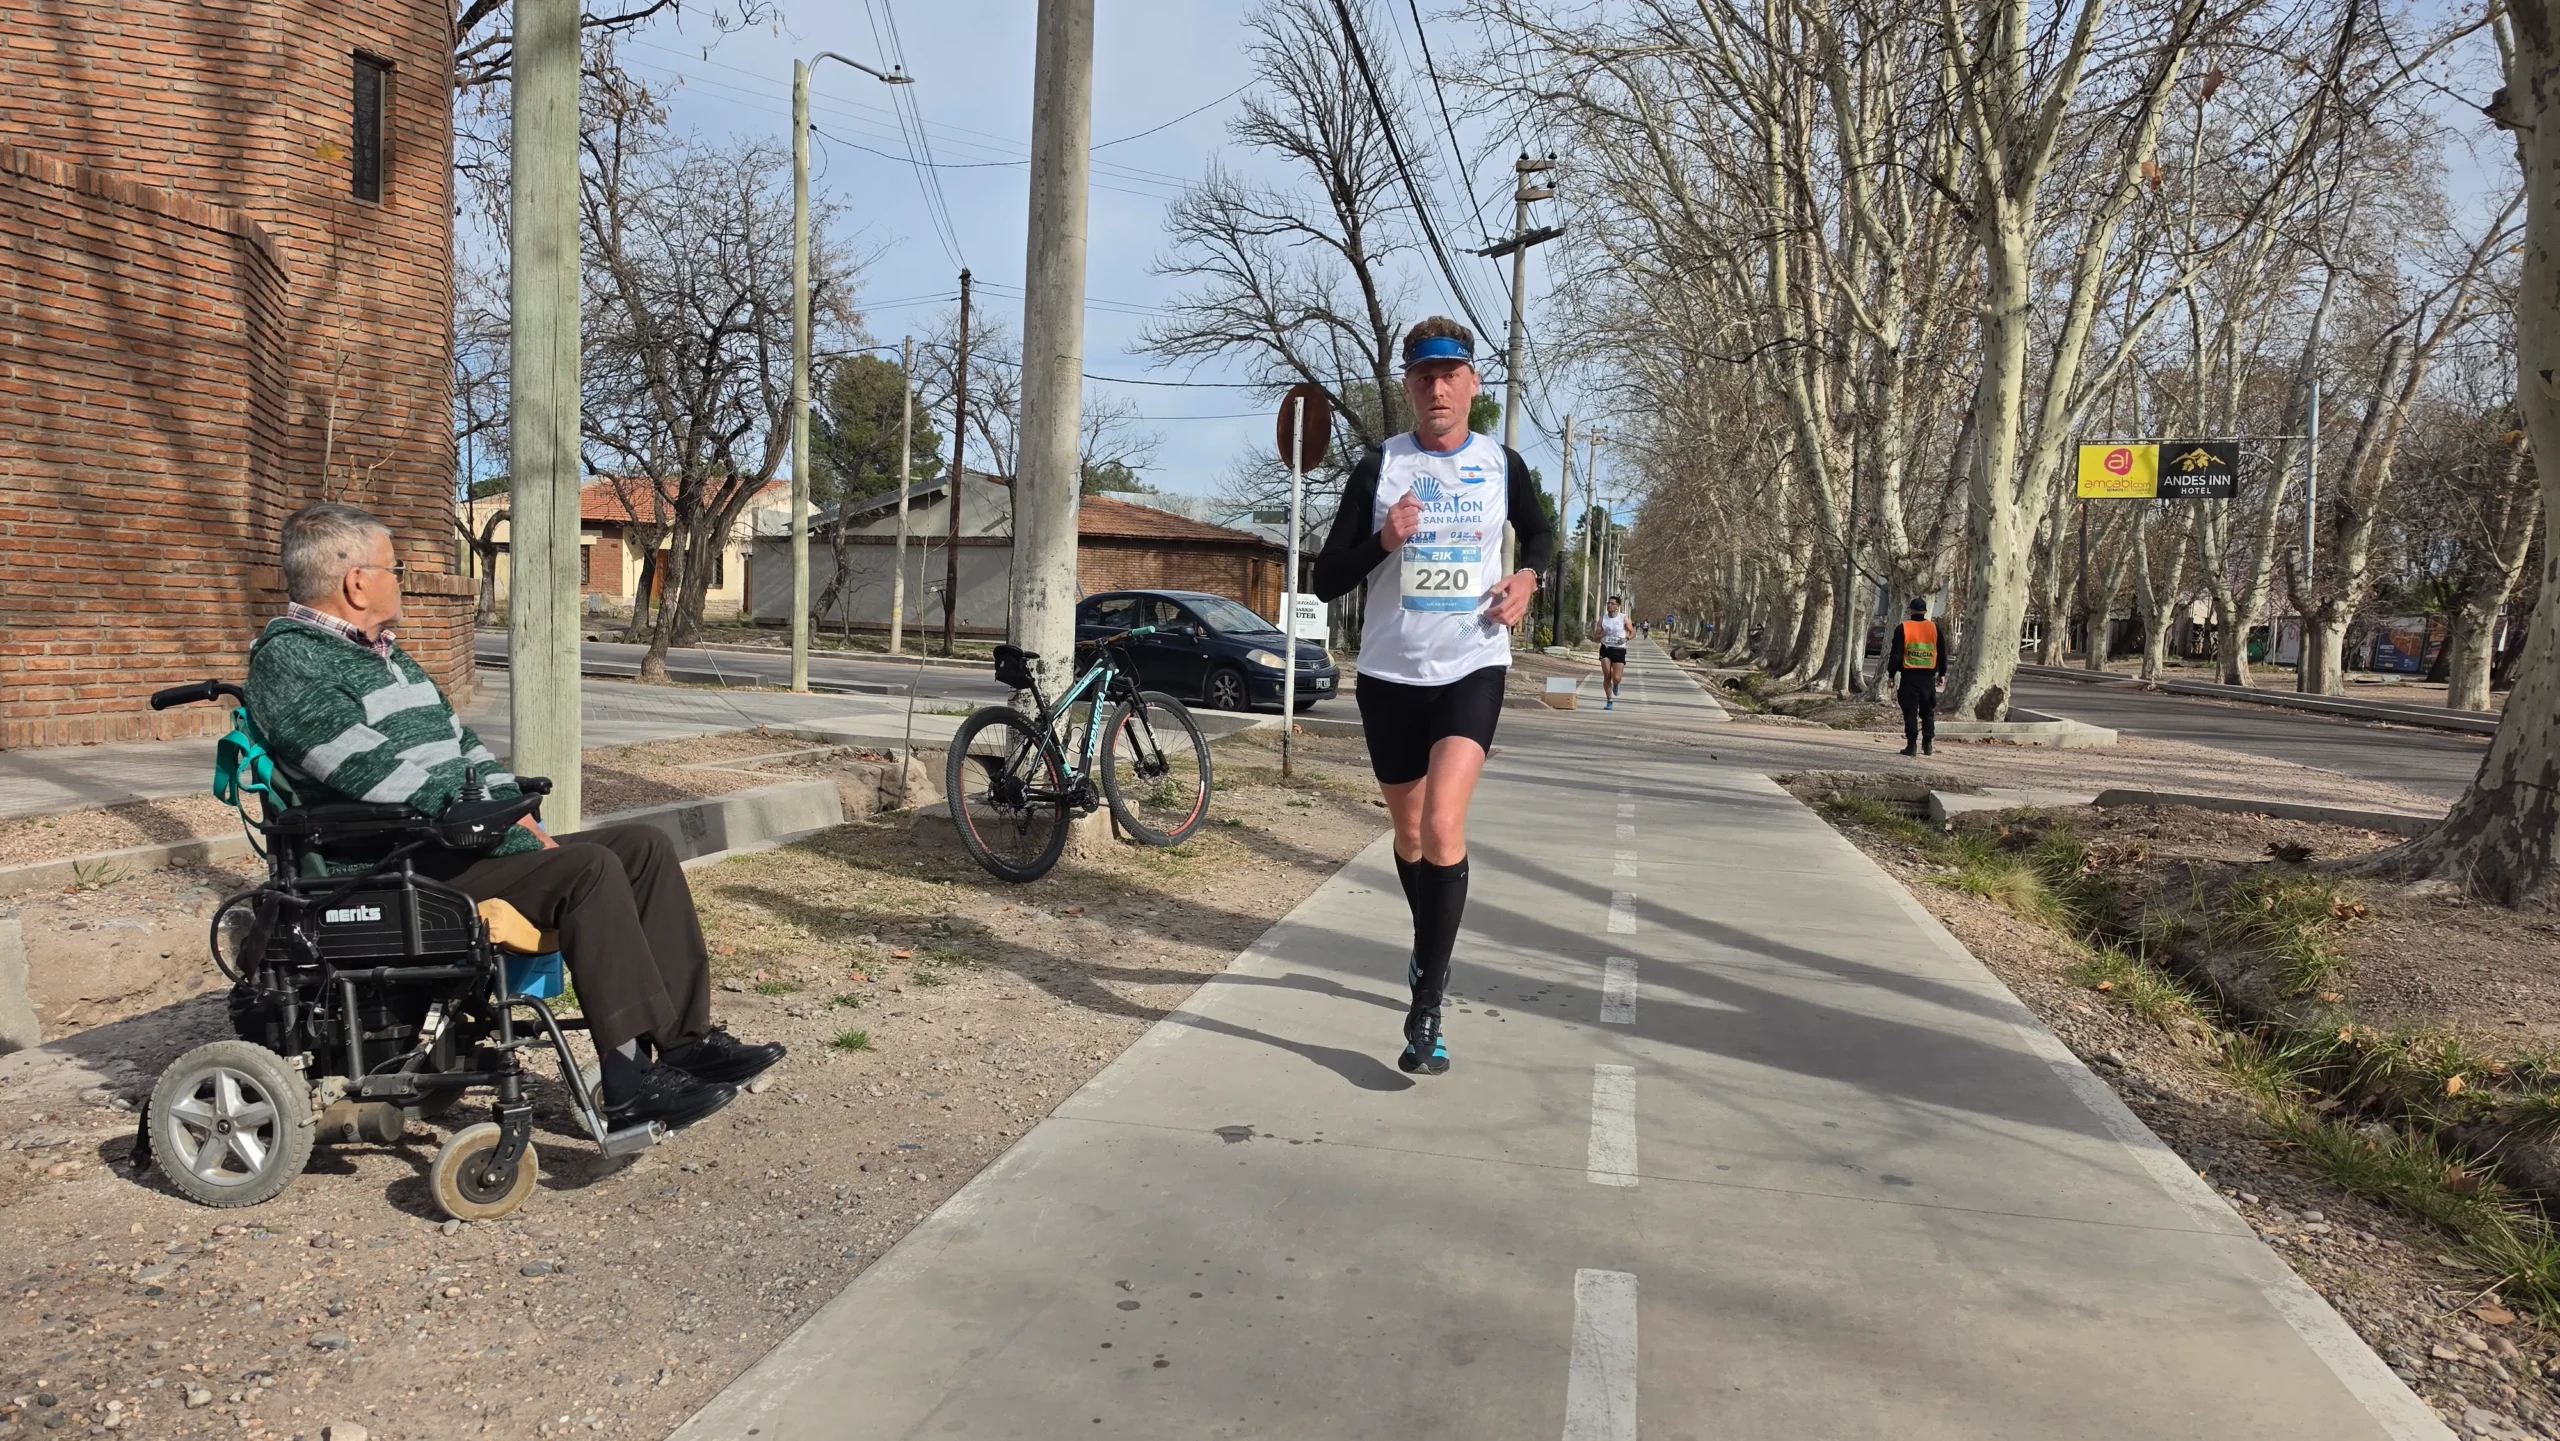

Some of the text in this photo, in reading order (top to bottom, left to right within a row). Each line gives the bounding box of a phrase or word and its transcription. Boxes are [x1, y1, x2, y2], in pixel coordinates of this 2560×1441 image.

[2163, 474, 2231, 486] ANDES INN
[1418, 500, 1483, 514] ARATON
[1423, 515, 1482, 524] SAN RAFAEL
[1431, 551, 1453, 560] 21K
[1415, 568, 1469, 591] 220
